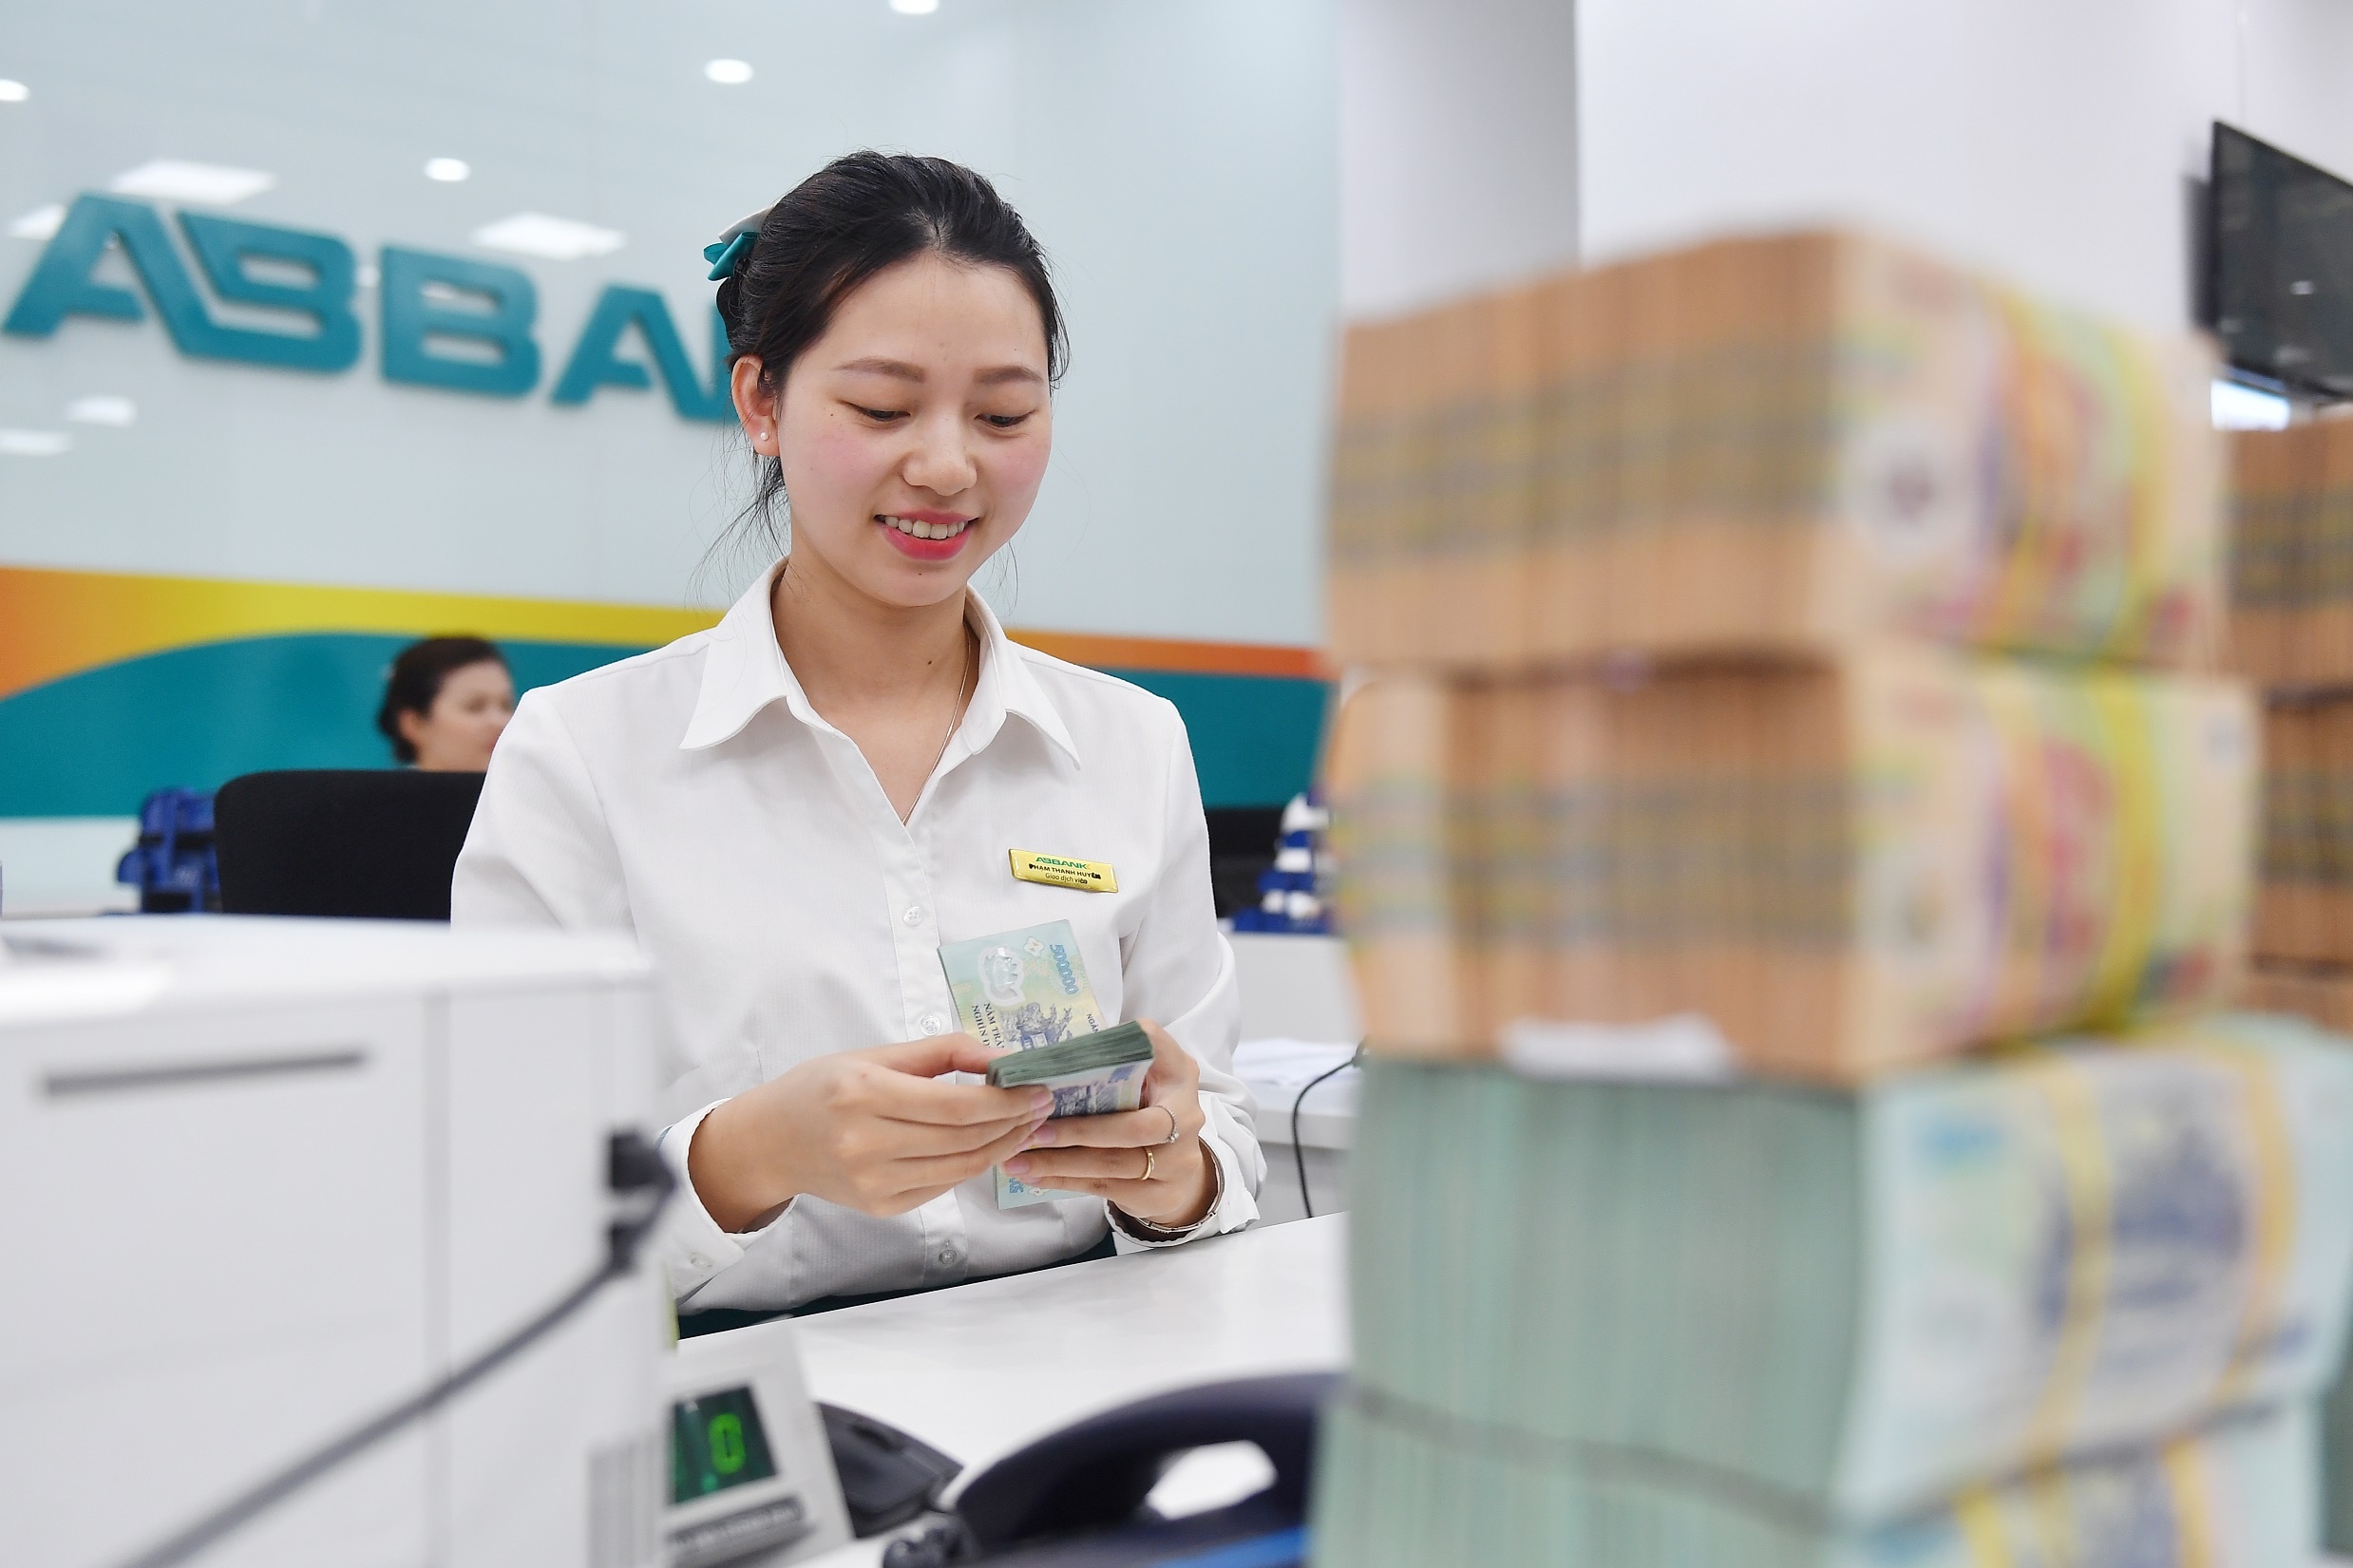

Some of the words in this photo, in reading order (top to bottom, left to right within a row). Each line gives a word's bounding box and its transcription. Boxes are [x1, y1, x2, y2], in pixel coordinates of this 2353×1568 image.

[1035, 857, 1088, 870] ABBANK
[992, 1027, 1004, 1048] TRĂ
[709, 1412, 747, 1474] 0
